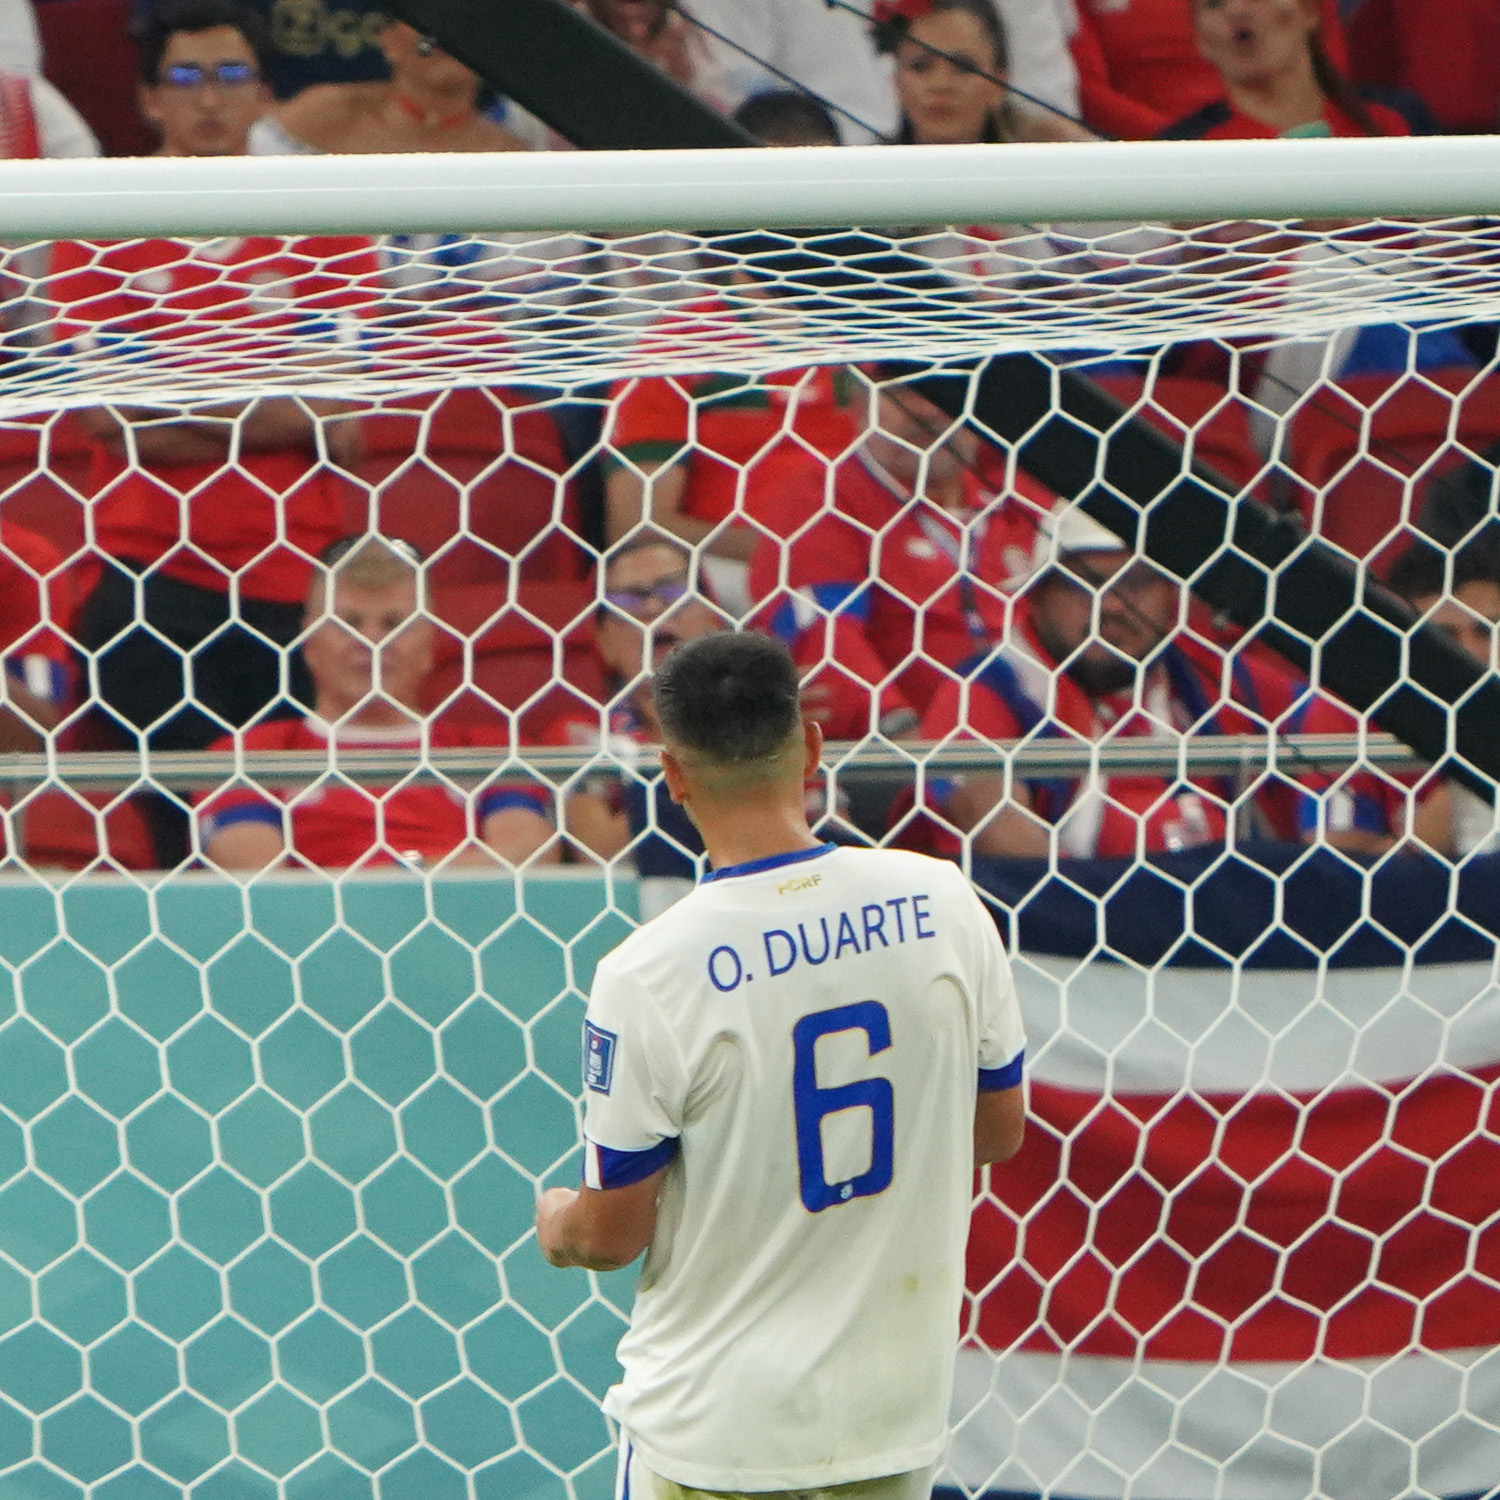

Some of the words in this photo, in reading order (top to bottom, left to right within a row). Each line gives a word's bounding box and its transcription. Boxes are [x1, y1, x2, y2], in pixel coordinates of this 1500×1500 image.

[708, 945, 753, 992] O.
[763, 895, 936, 977] DUARTE
[792, 1000, 894, 1214] 6
